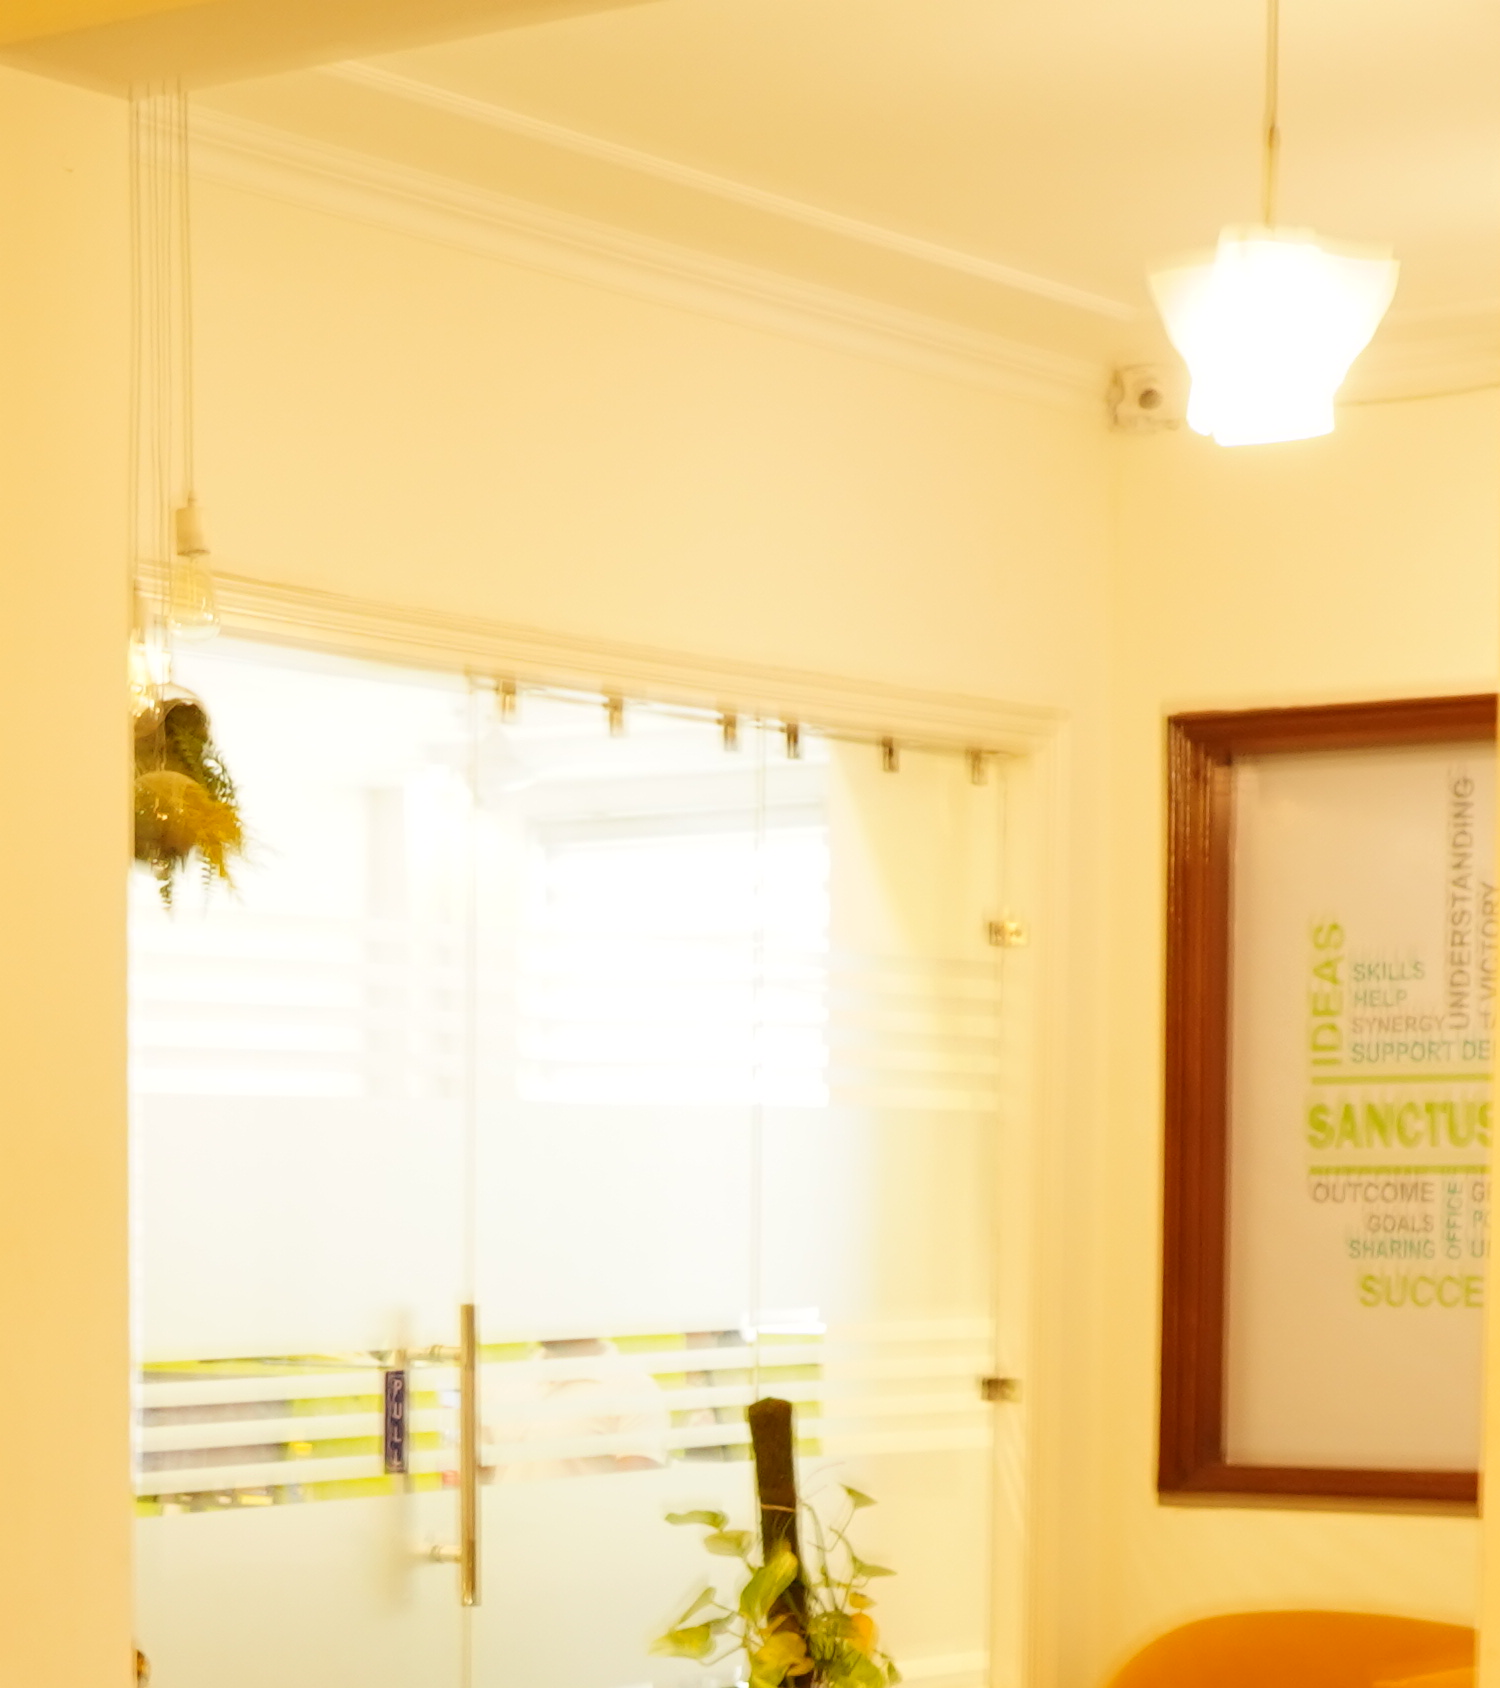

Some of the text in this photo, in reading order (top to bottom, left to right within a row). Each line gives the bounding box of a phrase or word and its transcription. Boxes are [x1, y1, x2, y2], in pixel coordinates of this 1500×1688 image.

[1450, 777, 1475, 1030] UNDERSTANDING
[1479, 881, 1499, 1004] VICTORY
[1352, 961, 1425, 982] SKILLS
[1310, 921, 1344, 1066] IDEAS
[1353, 989, 1408, 1008] HELP
[1351, 1015, 1445, 1034] SYNERGY
[1351, 1040, 1454, 1063] SUPPORT
[1312, 1181, 1435, 1204] OUTCOME
[1367, 1214, 1434, 1234] GOALS
[1446, 1182, 1463, 1260] OFFICE
[1349, 1240, 1435, 1260] SHARING
[391, 1379, 403, 1466] PULL
